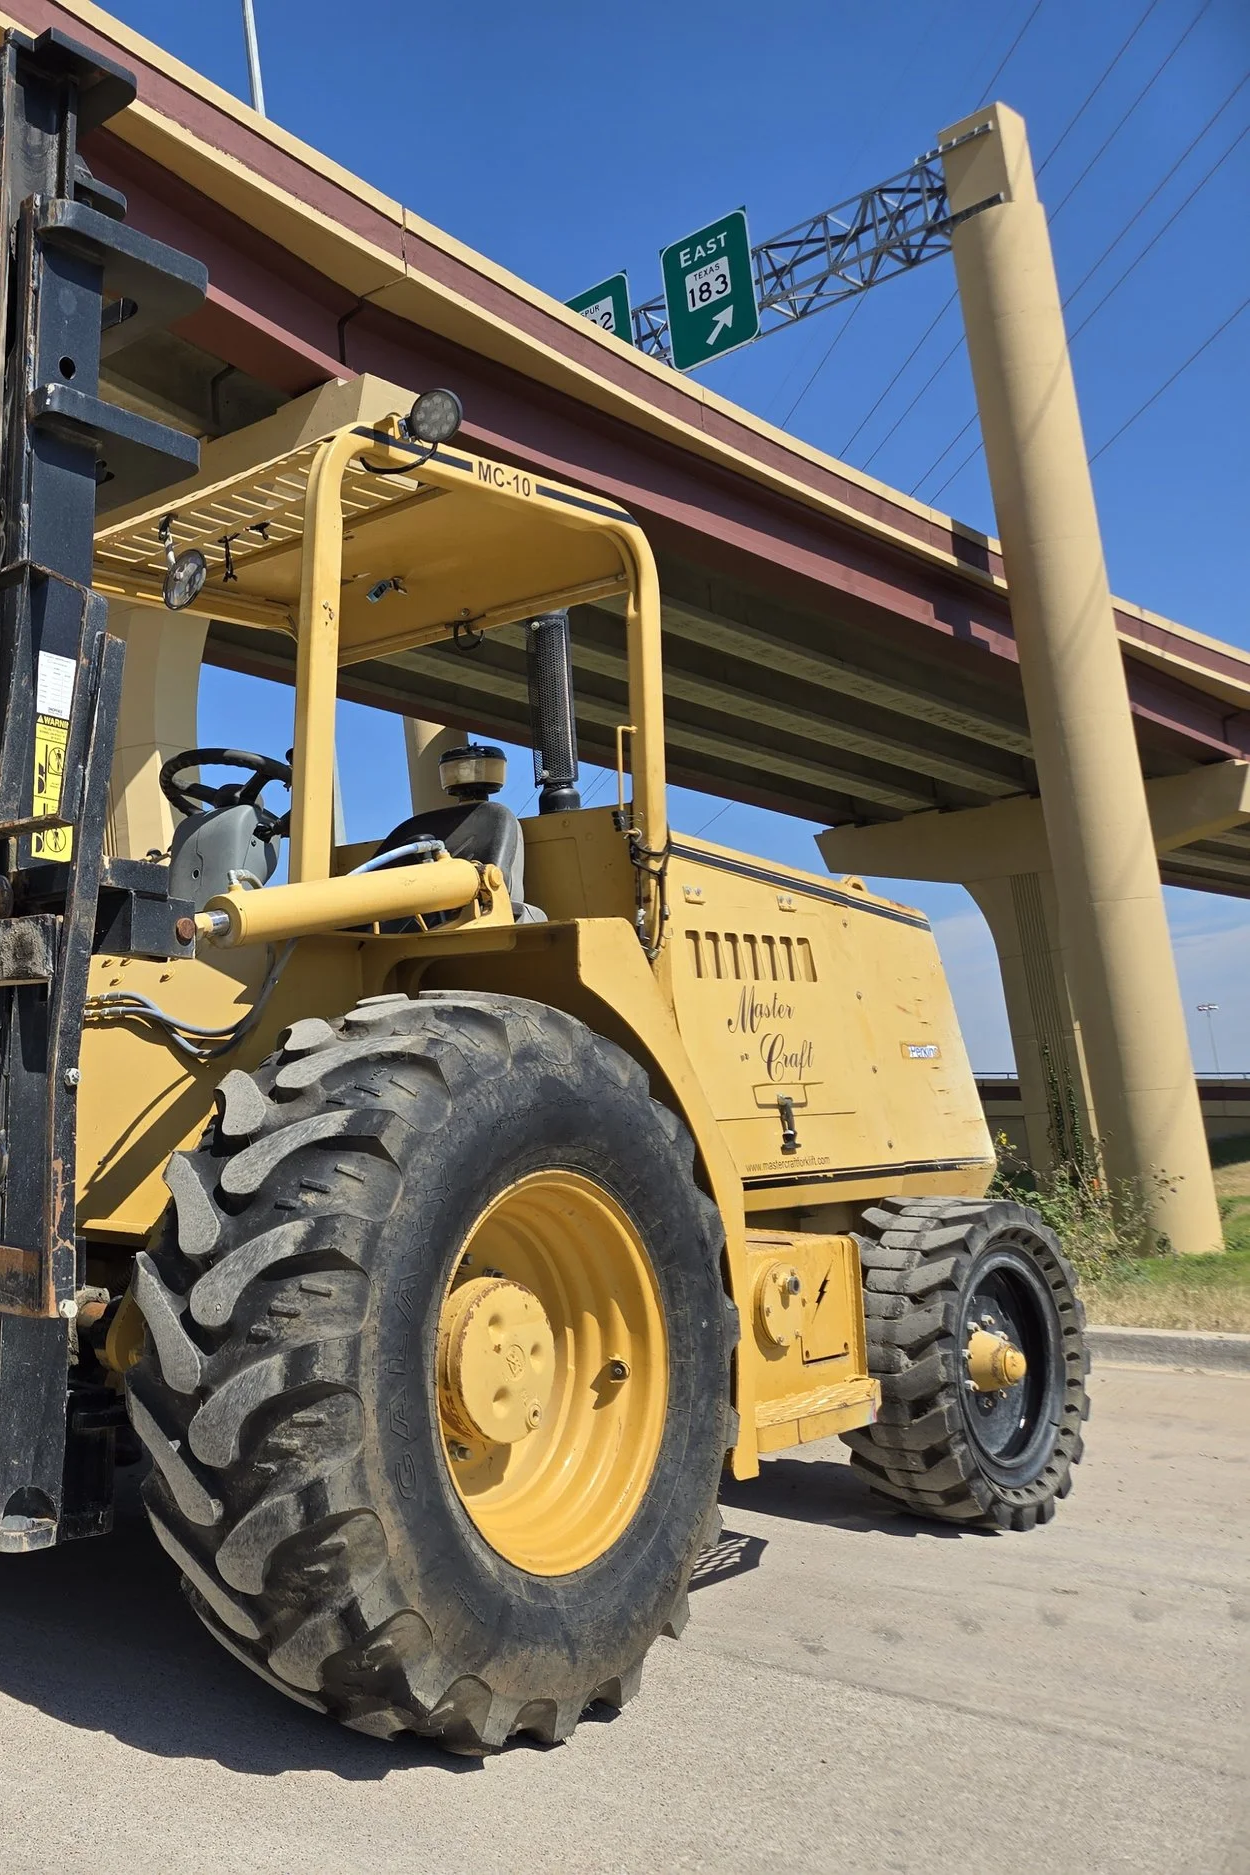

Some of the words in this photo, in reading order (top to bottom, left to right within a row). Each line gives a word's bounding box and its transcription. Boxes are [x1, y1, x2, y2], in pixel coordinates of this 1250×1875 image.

[679, 231, 728, 268] EAST
[693, 262, 720, 281] TEXAS
[689, 273, 728, 308] 183
[478, 460, 530, 497] MC-10
[727, 985, 795, 1034] Master
[760, 1033, 814, 1082] Craft
[745, 1155, 831, 1172] www.mastercraftforklift.com
[386, 1161, 451, 1499] GALAXY
